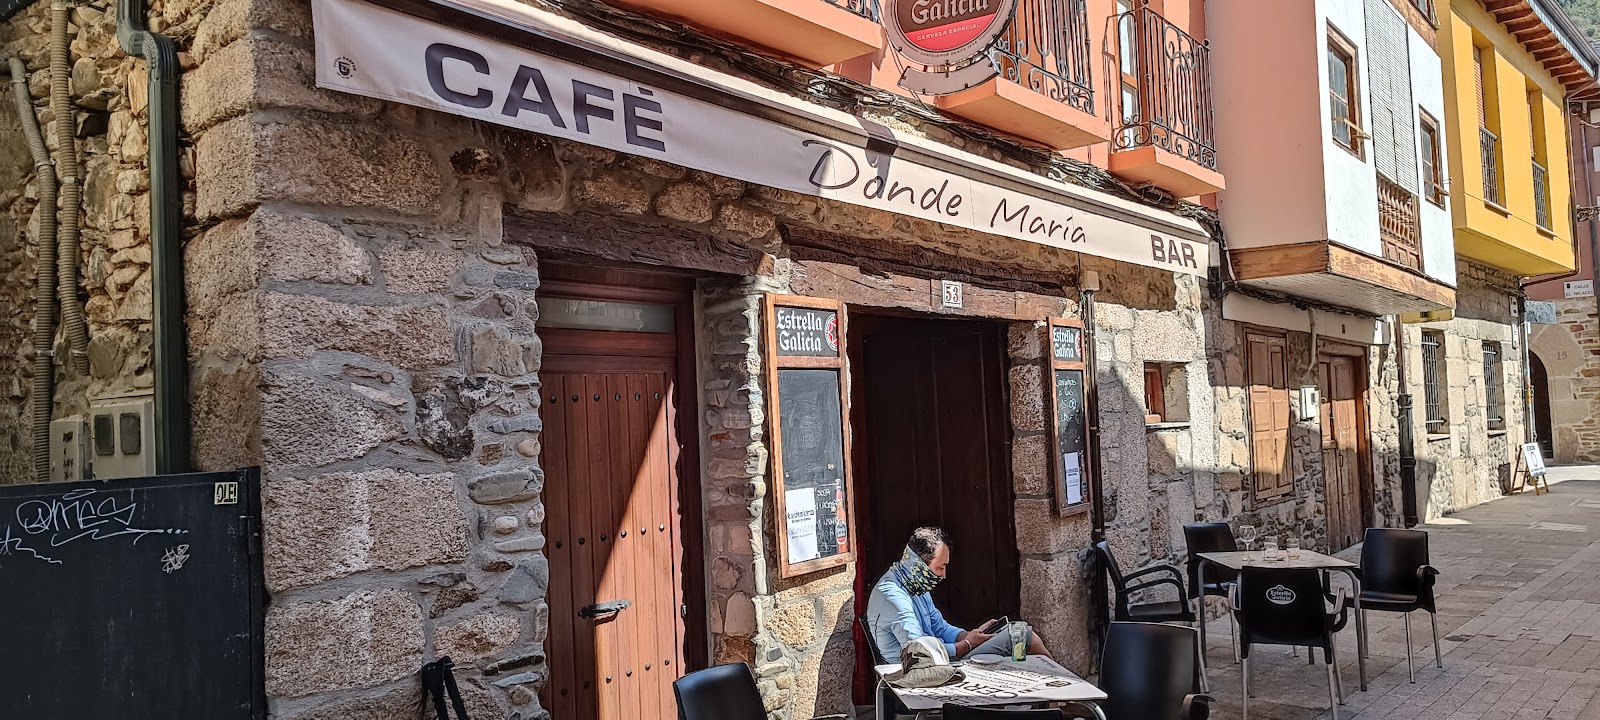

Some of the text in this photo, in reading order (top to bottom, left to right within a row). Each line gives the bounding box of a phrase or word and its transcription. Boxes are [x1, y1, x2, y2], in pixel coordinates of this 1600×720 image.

[917, 23, 981, 40] CERVEZA ESPECIAL
[990, 198, 1086, 244] María
[1150, 234, 1198, 269] BAR
[945, 285, 959, 302] 53
[776, 309, 822, 331] Estrella
[779, 330, 822, 352] Galicia
[1053, 327, 1074, 344] Estrella
[1054, 342, 1074, 358] Galicia
[1557, 351, 1567, 360] 19
